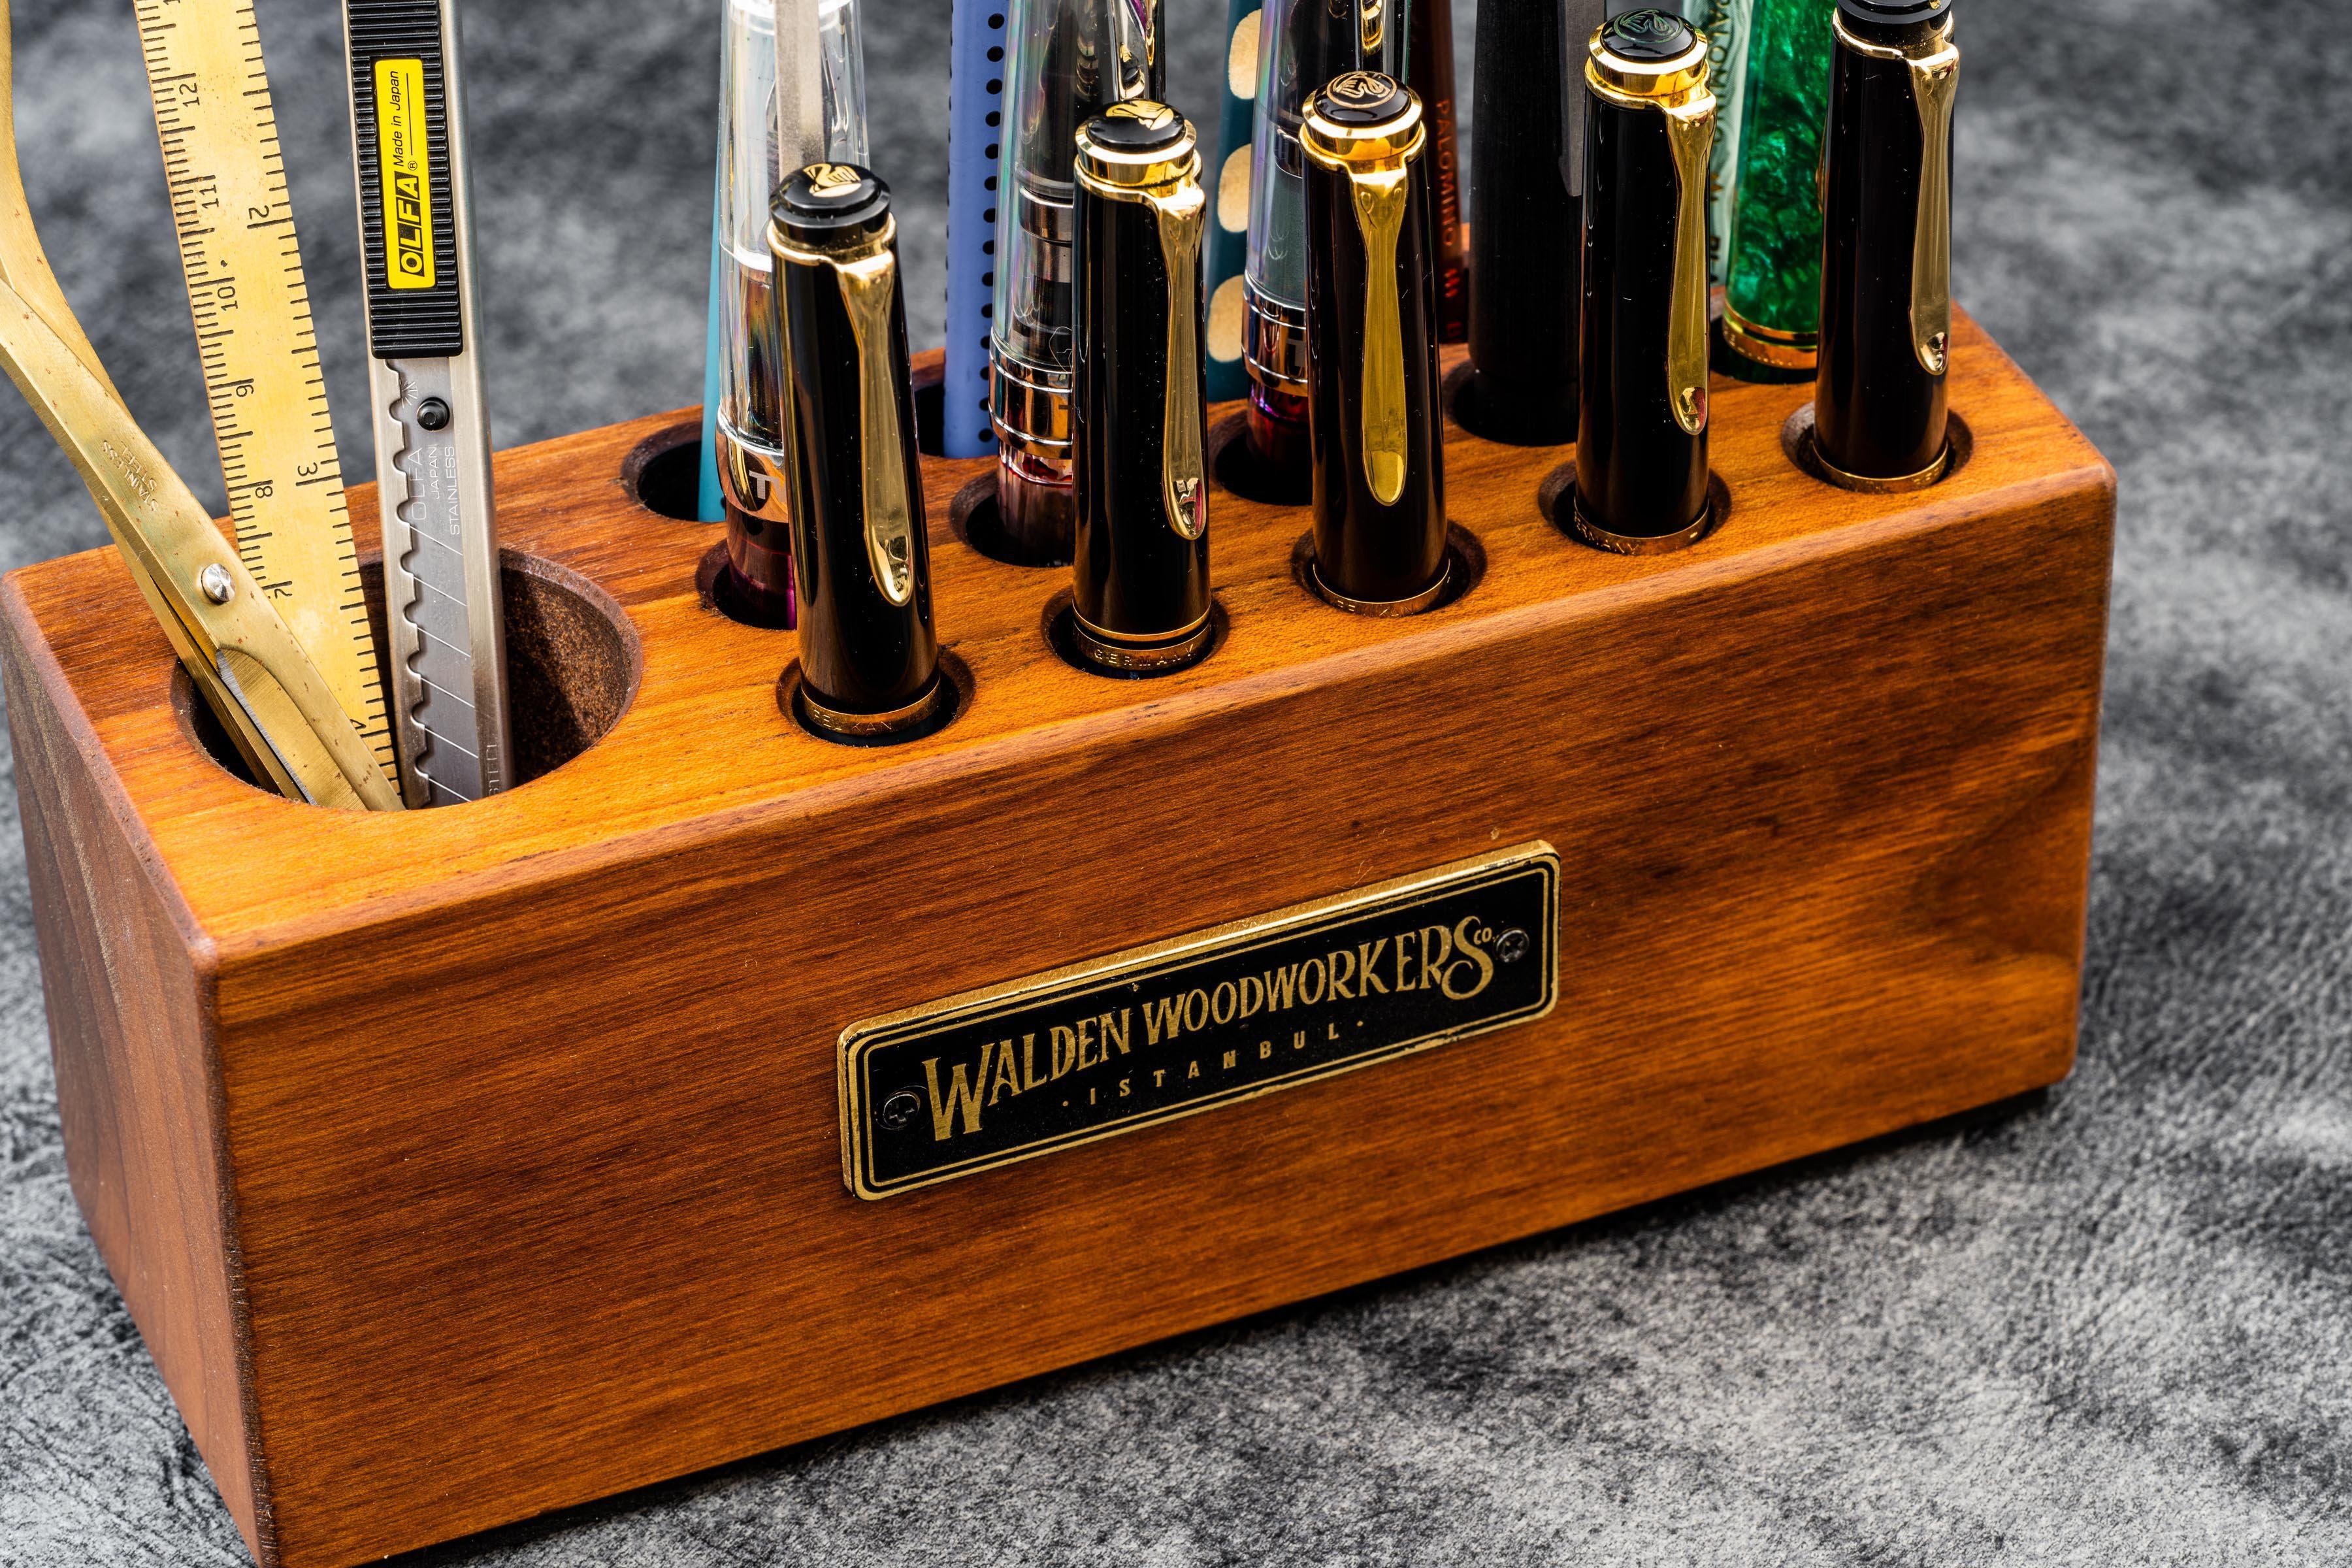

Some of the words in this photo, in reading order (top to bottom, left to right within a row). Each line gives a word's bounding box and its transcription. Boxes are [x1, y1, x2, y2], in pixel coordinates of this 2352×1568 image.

[178, 82, 200, 107] 12
[389, 71, 401, 111] Japan
[391, 116, 402, 127] in
[392, 131, 404, 167] Made
[1436, 99, 1456, 246] PALOMINO
[199, 184, 220, 209] 11
[248, 205, 270, 220] 2
[395, 174, 424, 275] OLFA
[217, 286, 238, 311] 10
[236, 384, 254, 397] 9
[297, 462, 318, 477] 3
[408, 447, 427, 521] OLFA
[428, 446, 440, 500] JAPAN
[255, 485, 273, 498] 8
[444, 446, 460, 535] STAINLESS
[813, 709, 893, 732] PELKAN
[921, 1007, 1132, 1142] WALDEN
[1141, 915, 1494, 1045] WOODWORKERS
[1090, 1022, 1340, 1105] ISTANBUL
